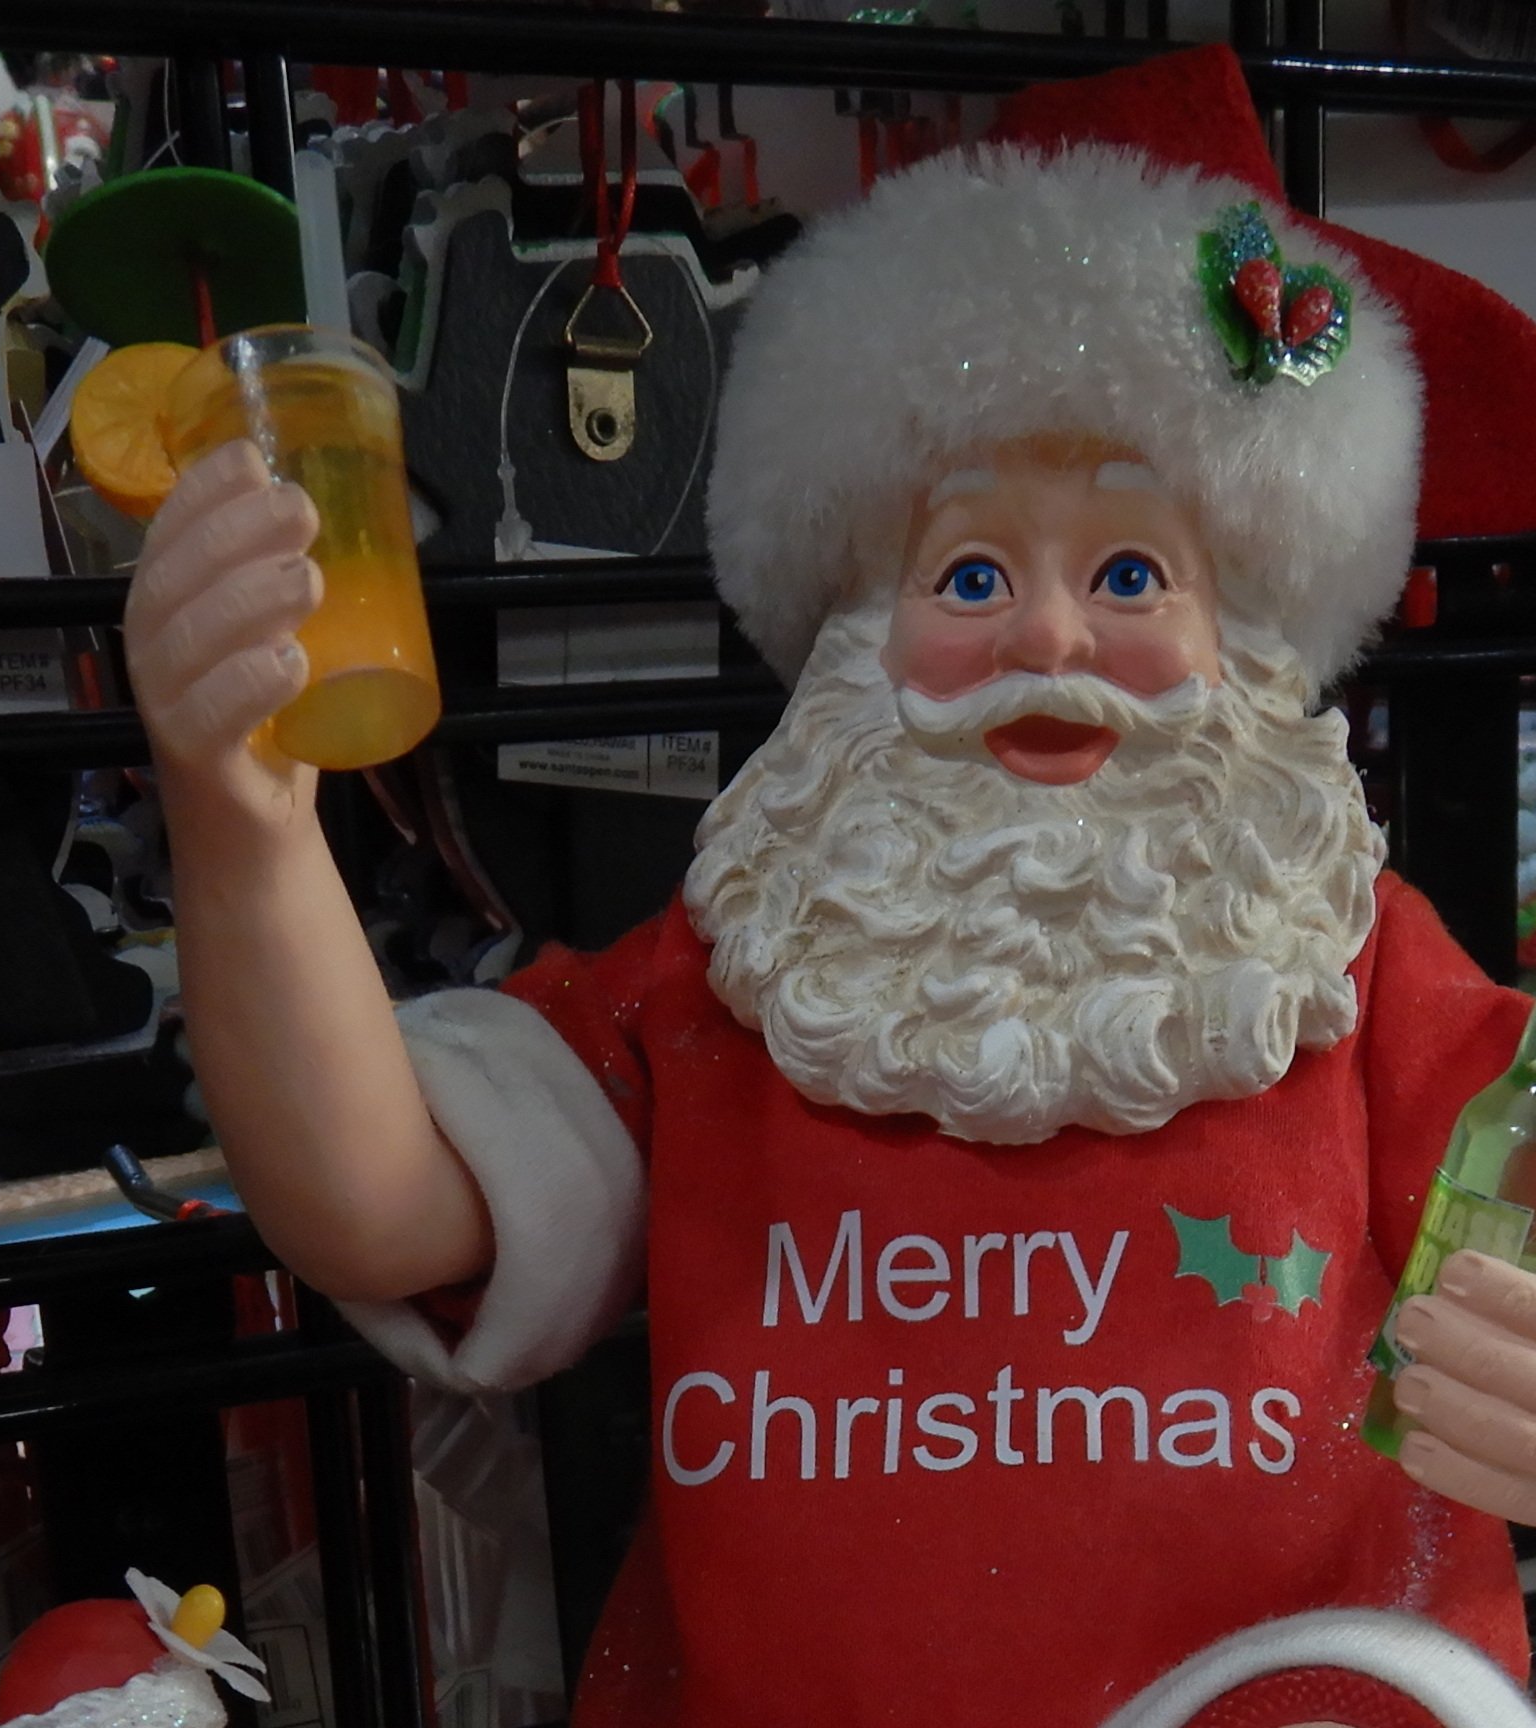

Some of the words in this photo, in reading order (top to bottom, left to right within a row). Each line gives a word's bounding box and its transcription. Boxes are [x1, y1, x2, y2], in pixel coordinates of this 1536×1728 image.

[0, 674, 47, 691] PF34
[762, 1208, 1130, 1346] Merry
[662, 1363, 1302, 1487] Christmas
